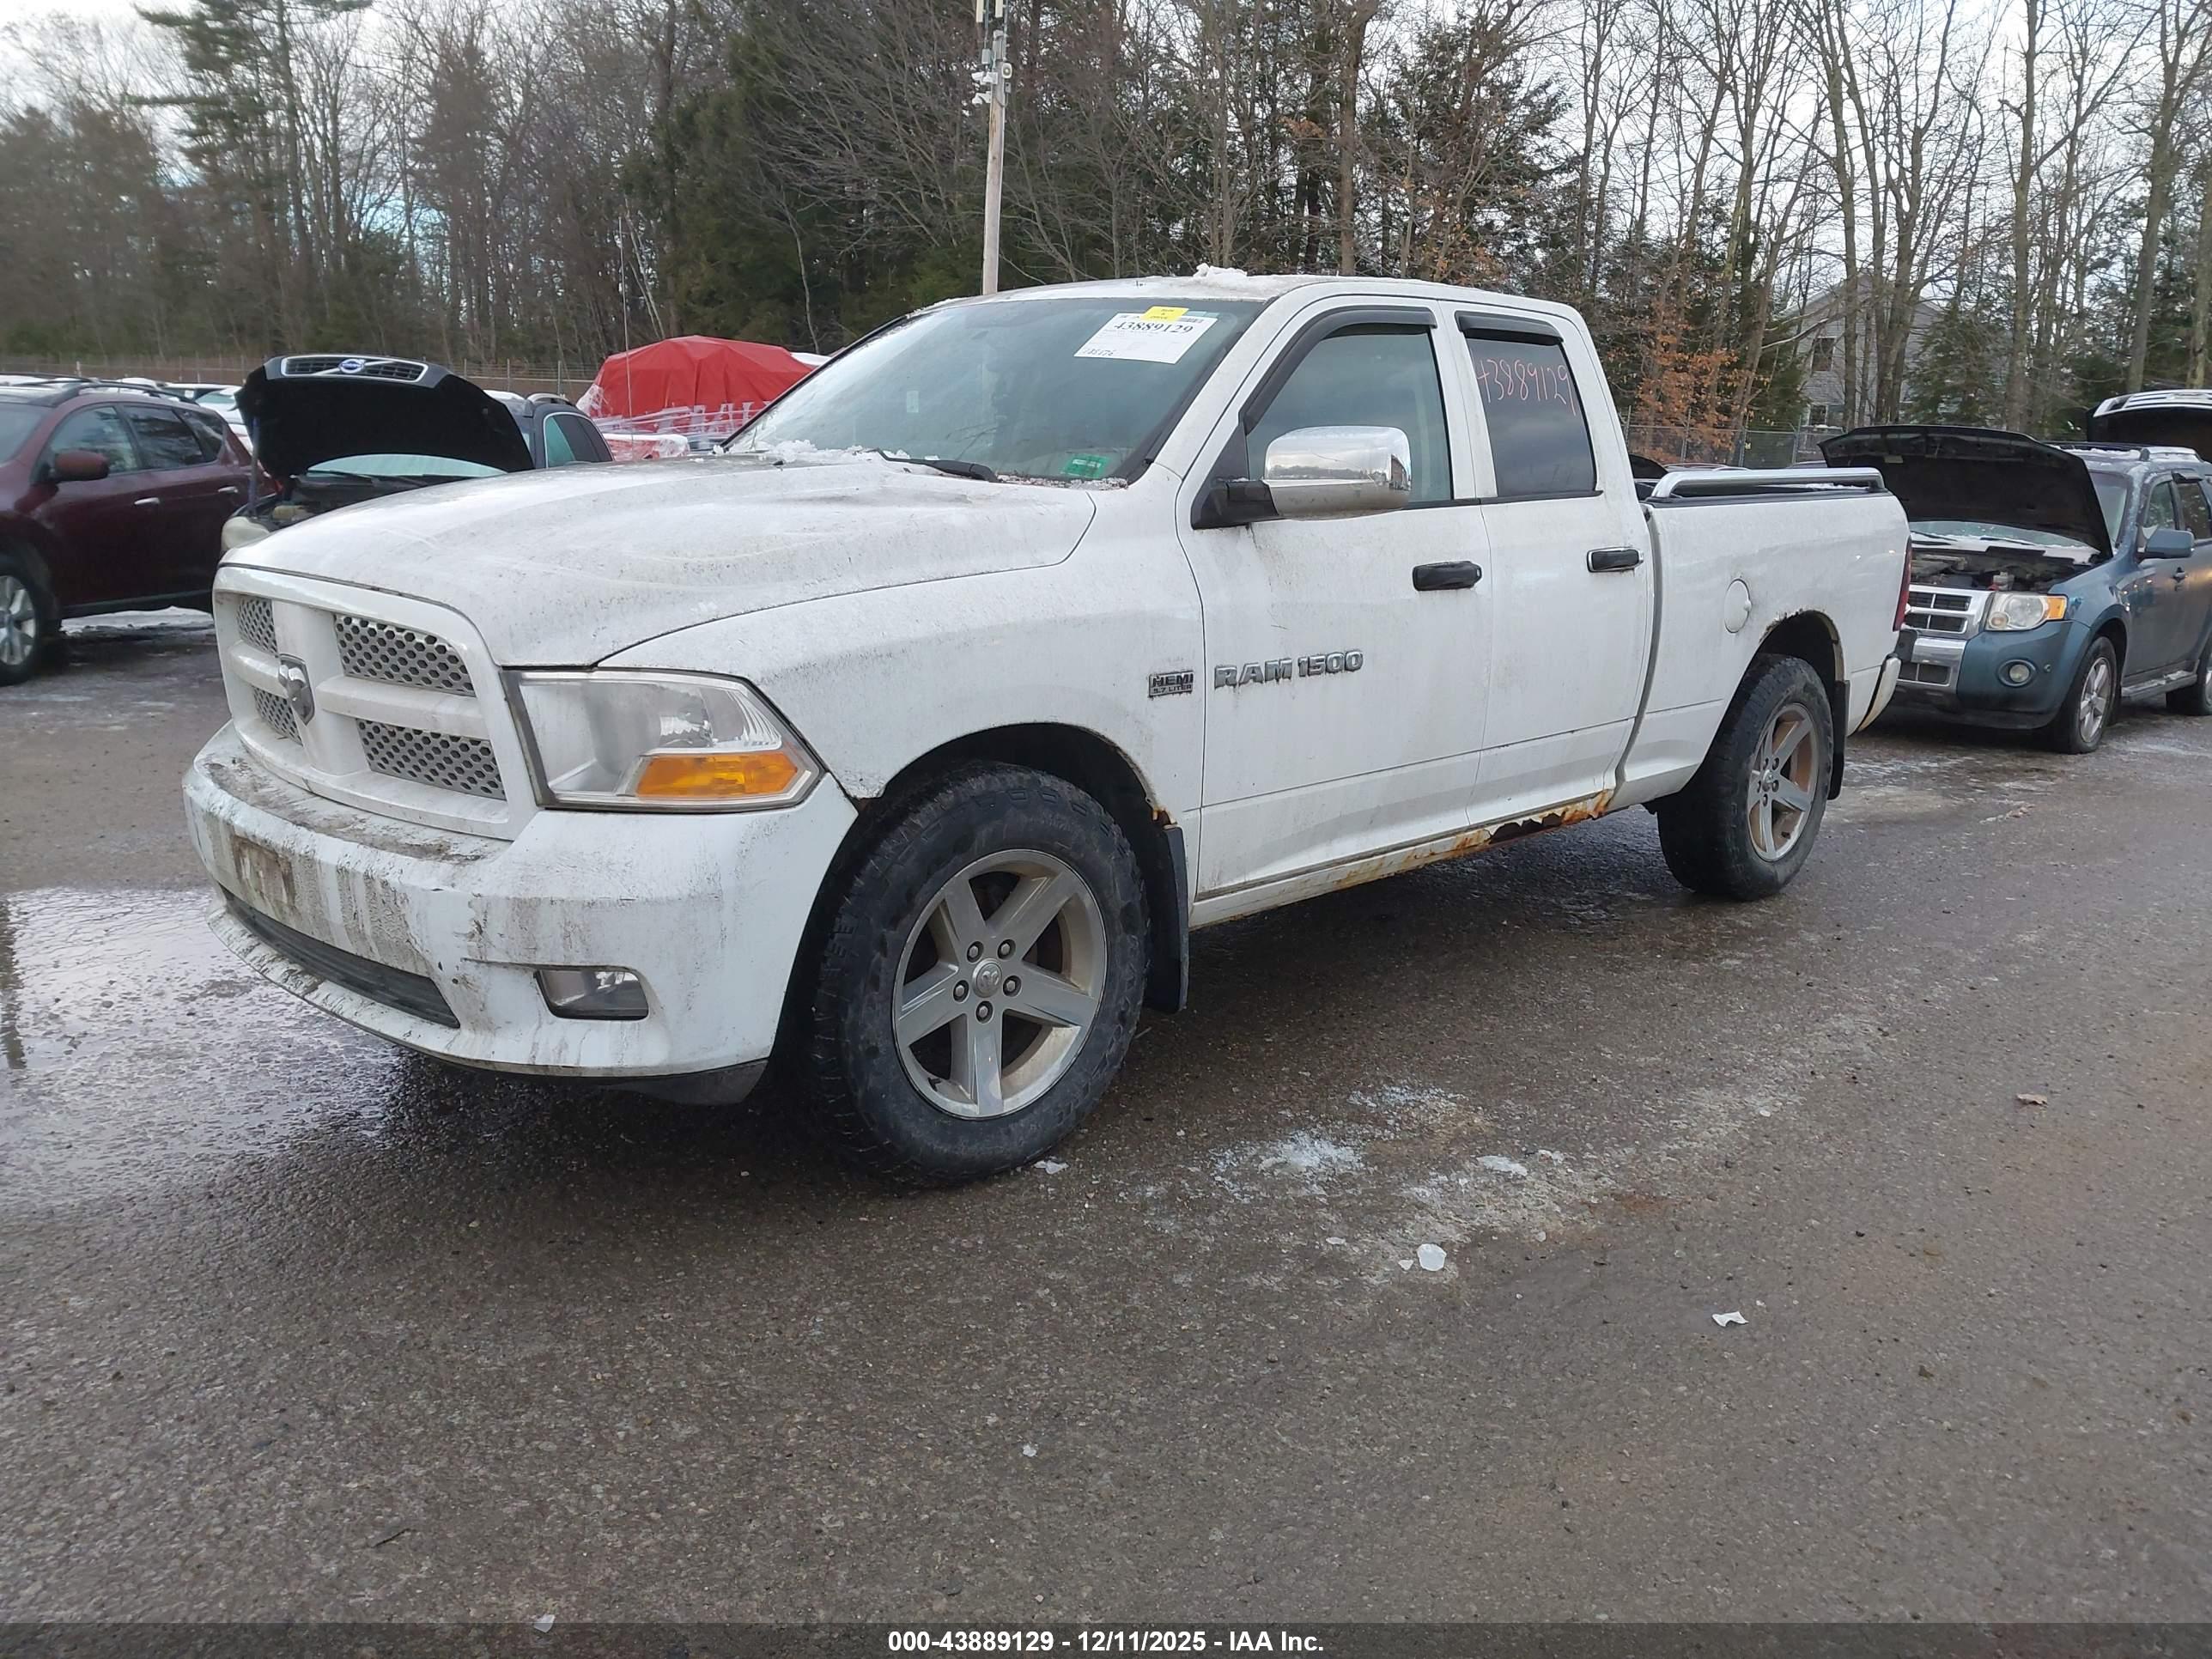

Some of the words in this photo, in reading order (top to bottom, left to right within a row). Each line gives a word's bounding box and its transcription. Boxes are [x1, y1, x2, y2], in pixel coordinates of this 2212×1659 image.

[1114, 320, 1194, 334] 43889129
[1213, 659, 1291, 689] RAM
[1297, 649, 1364, 677] 1500
[1152, 672, 1194, 687] HEMI
